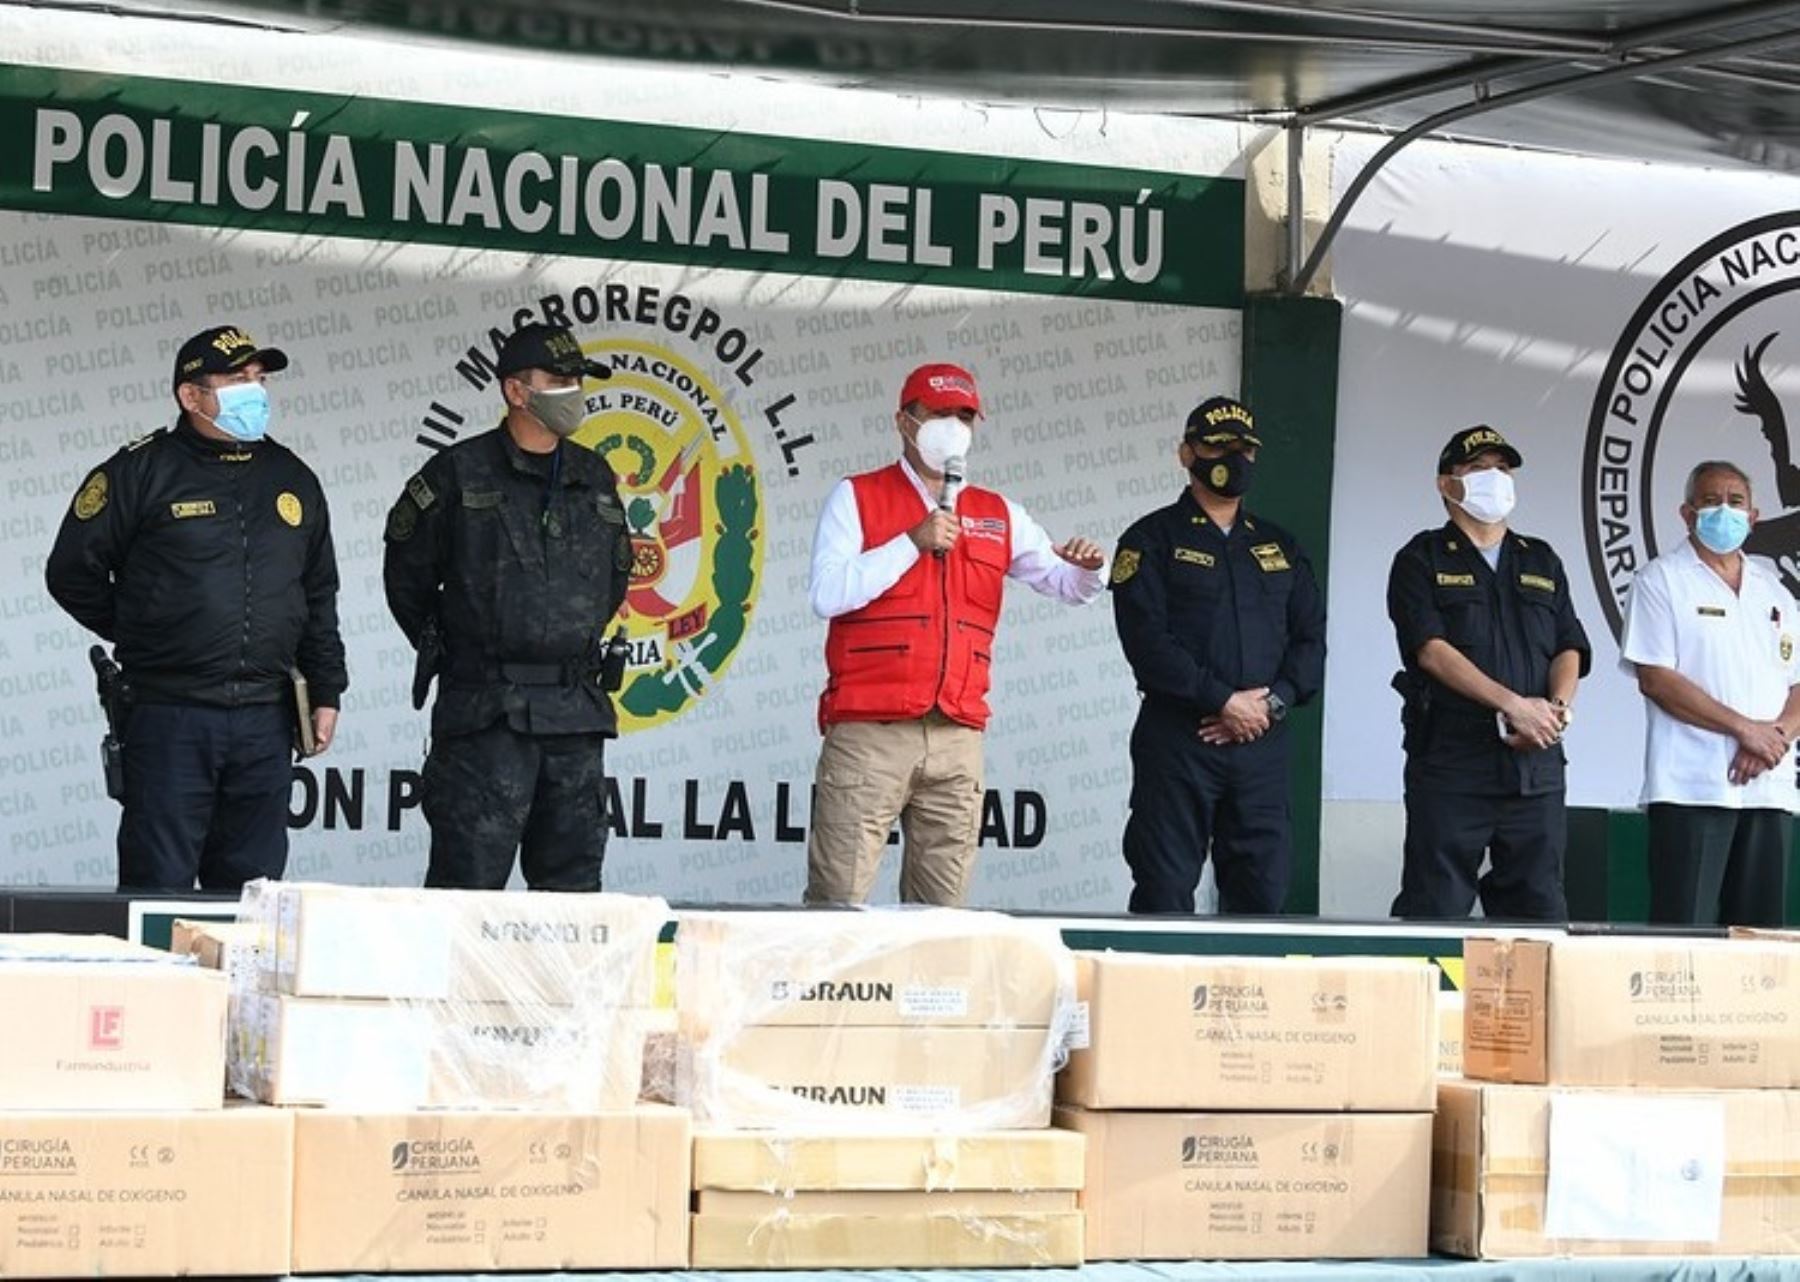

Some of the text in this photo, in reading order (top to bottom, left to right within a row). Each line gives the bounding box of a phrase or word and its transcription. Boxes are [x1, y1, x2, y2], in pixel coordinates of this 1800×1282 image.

[32, 111, 1165, 284] POLICÍA NACIONAL DEL PERÚ
[1, 234, 60, 267] LICÍA
[33, 266, 122, 300] POLICÍA
[144, 250, 233, 285] POLICÍA
[314, 266, 400, 299] POLICÍA
[95, 292, 184, 330] POLICÍA
[206, 279, 293, 315] POLICÍA
[374, 292, 459, 328] POLICÍA
[0, 311, 72, 346] OLICÍA
[266, 309, 352, 343] POLICÍA
[795, 308, 875, 339] POLICÍA
[946, 316, 1023, 351] POLICÍA
[1040, 303, 1116, 335] POLICÍA
[1186, 318, 1241, 347] POLIC
[45, 340, 135, 377] POLICÍA
[327, 337, 412, 373] POLICÍA
[850, 333, 928, 365] POLICÍA
[1001, 346, 1076, 379] POLICÍA
[1094, 331, 1168, 362] POLICÍA
[1610, 274, 1722, 426] POLICIA
[1052, 373, 1128, 404] POLICÍA
[1145, 358, 1219, 389] POLICÍA
[107, 376, 173, 407] POLIC
[279, 385, 366, 419] POLICÍA
[610, 352, 728, 443] NACIONAL
[807, 376, 885, 408] POLICÍA
[585, 392, 681, 428] EL PERÚ
[1105, 400, 1180, 432] POLICÍA
[764, 392, 815, 478] L.L.
[1012, 415, 1087, 447] POLICÍA
[1064, 441, 1140, 473] POLICÍA
[9, 462, 82, 500] POLICÍ
[668, 604, 707, 640] LEY
[0, 667, 75, 699] OLICÍA
[1004, 667, 1080, 699] POLICÍA
[711, 722, 793, 757] POLICÍA
[1015, 735, 1090, 769] POLICÍA
[684, 777, 756, 843] LA
[10, 816, 100, 854] POLICÍA
[801, 981, 893, 1002] BRAUN
[3, 1156, 76, 1169] PERUANA
[412, 1156, 480, 1168] PERUANA
[1198, 1151, 1258, 1162] PERUANA
[0, 1188, 44, 1201] ÁNULA
[50, 1190, 94, 1201] NASAL
[98, 1190, 113, 1201] DE
[456, 1187, 496, 1199] NASAL
[500, 1186, 517, 1197] DE
[1236, 1181, 1272, 1192] NASAL
[1276, 1181, 1290, 1192] DE
